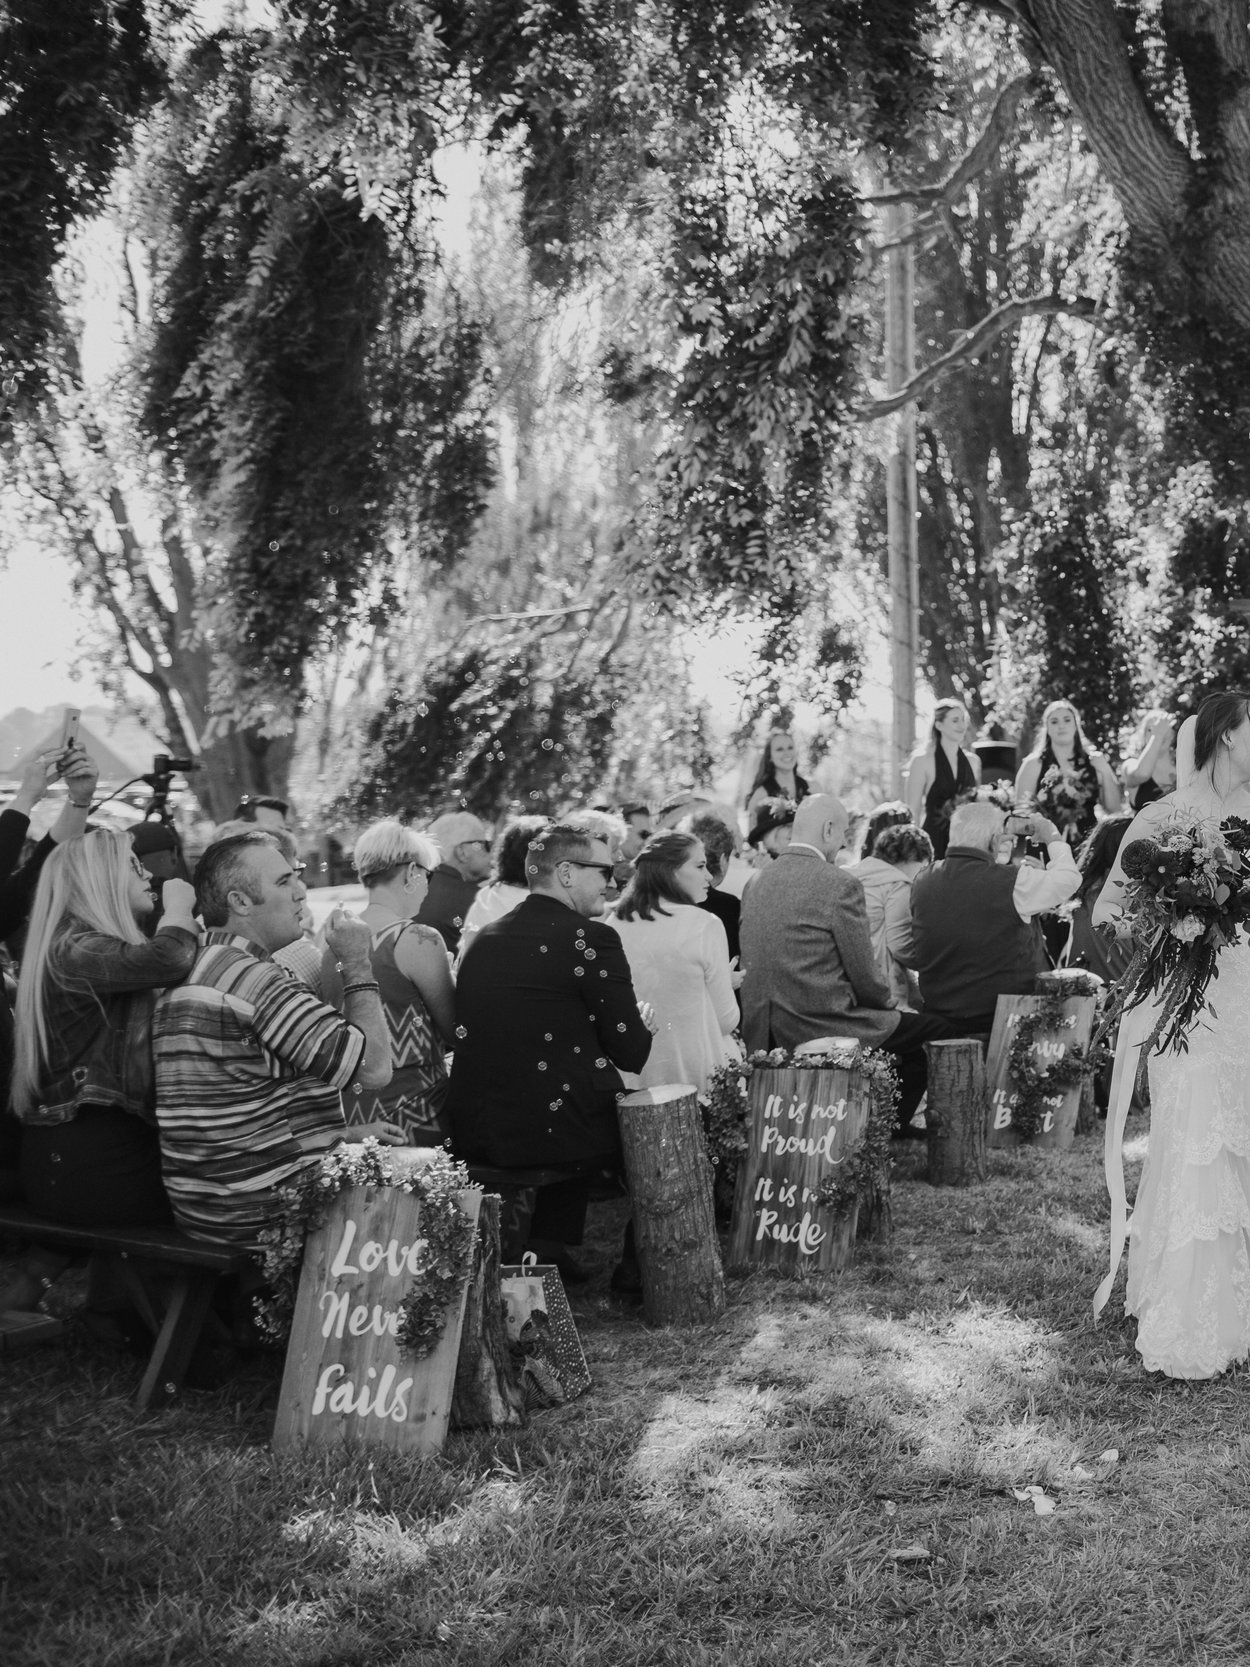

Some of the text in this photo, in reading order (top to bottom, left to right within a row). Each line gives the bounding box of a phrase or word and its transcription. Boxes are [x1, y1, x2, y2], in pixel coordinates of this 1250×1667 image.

[1027, 1040, 1066, 1066] nvy
[764, 1094, 847, 1124] It is not
[761, 1125, 845, 1165] Proud
[754, 1177, 774, 1202] It
[778, 1178, 797, 1208] is
[331, 1220, 439, 1277] Love
[756, 1208, 827, 1255] Rude
[319, 1291, 408, 1338] Neve
